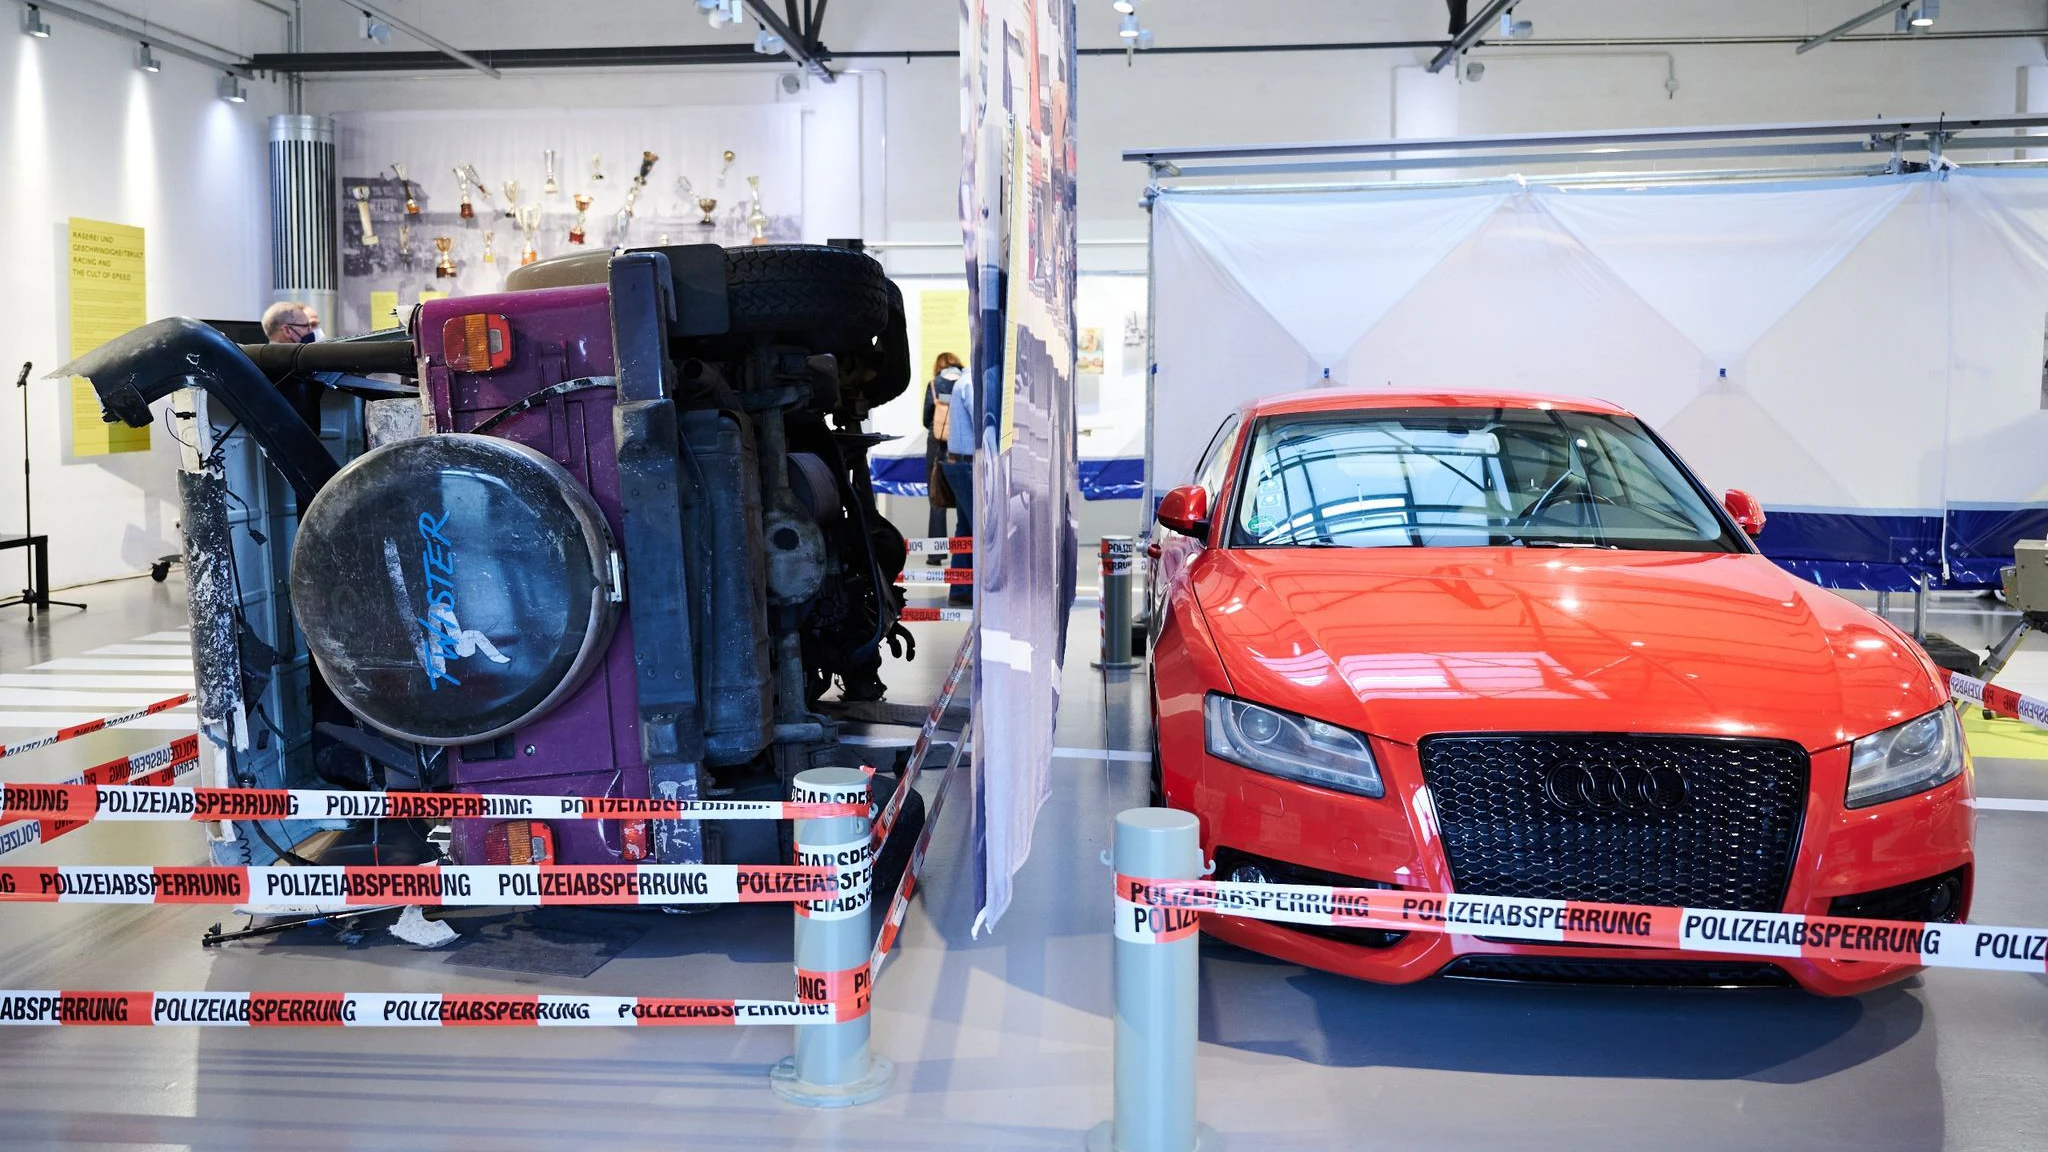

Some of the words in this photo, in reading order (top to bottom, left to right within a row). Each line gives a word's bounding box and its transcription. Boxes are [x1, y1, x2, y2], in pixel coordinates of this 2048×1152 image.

[101, 235, 113, 243] UND
[73, 257, 96, 266] RACING
[98, 259, 111, 267] AND
[73, 269, 85, 277] THE
[87, 270, 101, 278] CULT
[112, 272, 131, 281] SPEED
[417, 510, 461, 690] TWISTER
[0, 788, 69, 812] RRUNG
[96, 790, 299, 816] POLIZEIABSPERRUNG
[40, 873, 240, 896] POLIZEIABSPERRUNG
[267, 873, 471, 897] POLIZEIABSPERRUNG
[499, 873, 708, 896] POLIZEIABSPERRUNG
[1402, 898, 1651, 937] POLIZEIABSPERRUNG
[1685, 915, 1941, 956] POLIZEIABSPERRUNG
[1975, 932, 2048, 961] POLIZ
[0, 996, 128, 1021] ABSPERRUNG
[154, 998, 356, 1022] POLIZEIABSPERRUNG
[383, 1000, 590, 1021] POLIZEIABSPERRUNG
